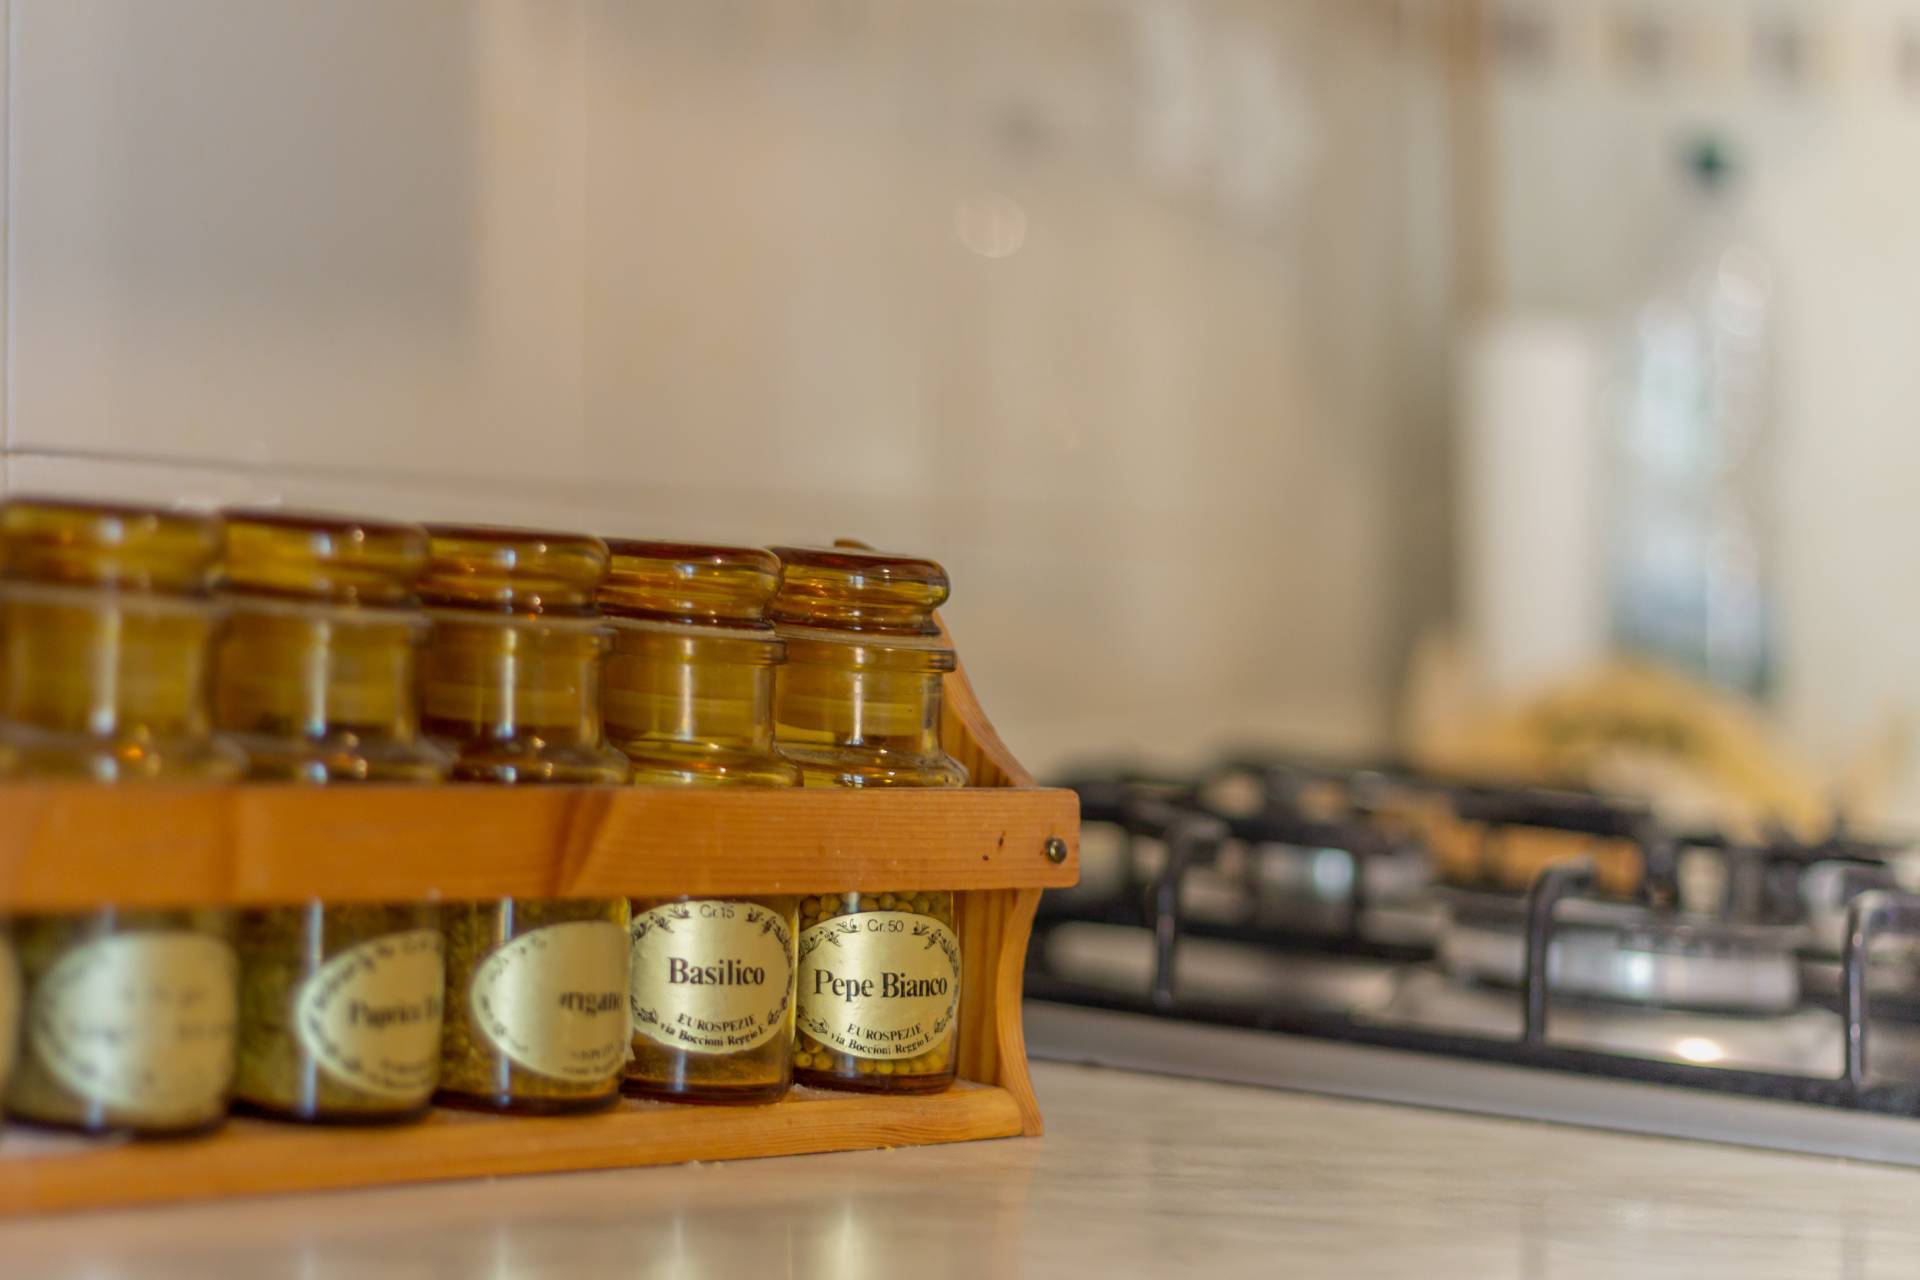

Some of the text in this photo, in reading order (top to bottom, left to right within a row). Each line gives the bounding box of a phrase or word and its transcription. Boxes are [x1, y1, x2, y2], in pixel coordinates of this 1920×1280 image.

[668, 957, 765, 986] Basilico
[814, 969, 948, 1003] Pepe Bianco
[677, 1013, 757, 1033] EUROSPEZIE
[847, 1023, 922, 1041] EUROSPEZIE
[831, 1033, 846, 1045] via
[848, 1039, 892, 1055] Boccioni
